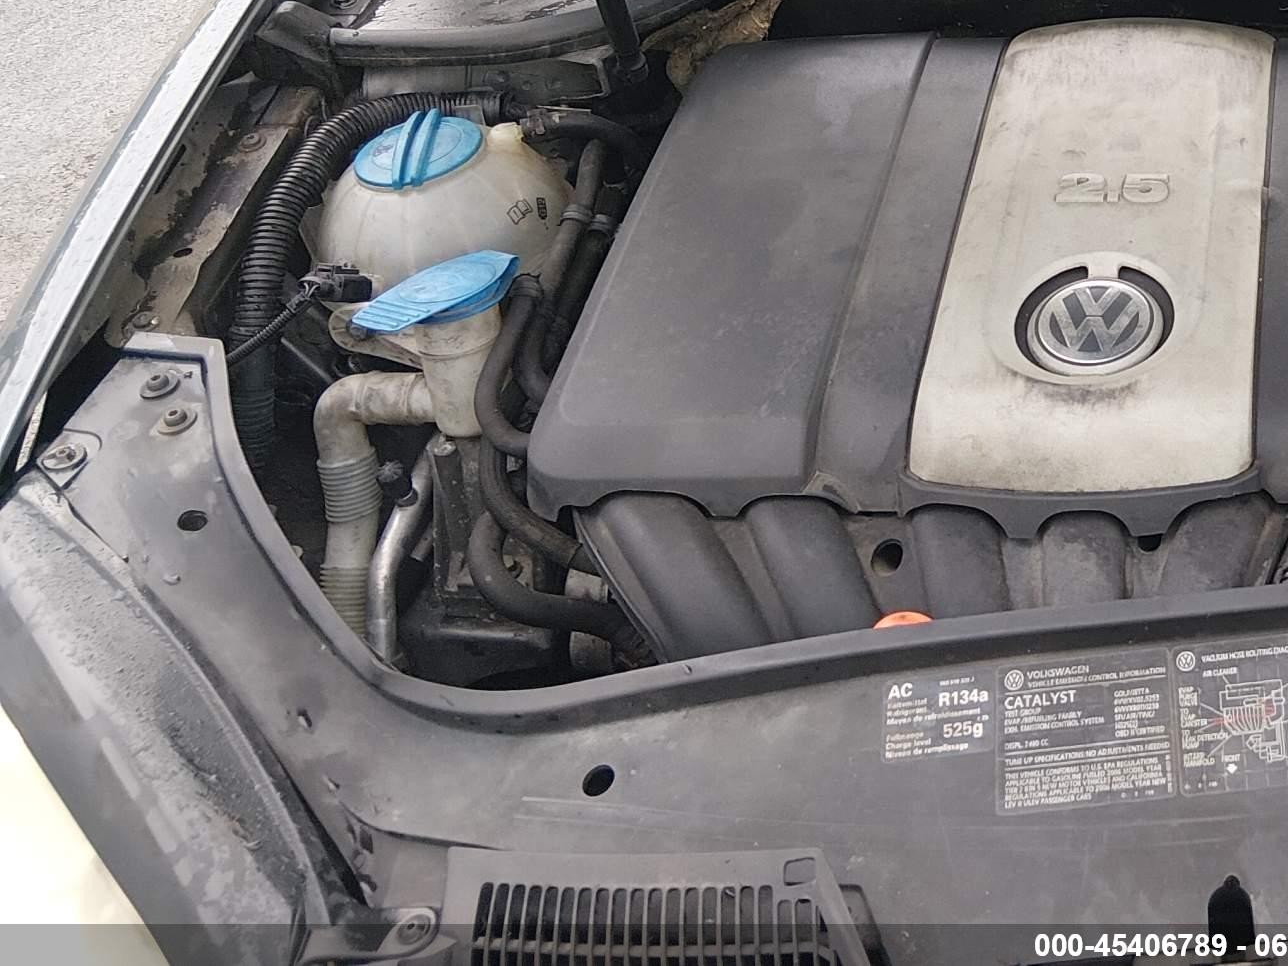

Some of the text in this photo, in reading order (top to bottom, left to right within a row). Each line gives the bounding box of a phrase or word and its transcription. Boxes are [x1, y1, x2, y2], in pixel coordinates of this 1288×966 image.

[1054, 173, 1170, 203] 2.5
[1026, 665, 1089, 680] VOLKSWAGEN
[888, 682, 913, 700] AC
[938, 688, 989, 707] R134a
[1004, 690, 1076, 710] CATALYST
[943, 720, 984, 738] 525g
